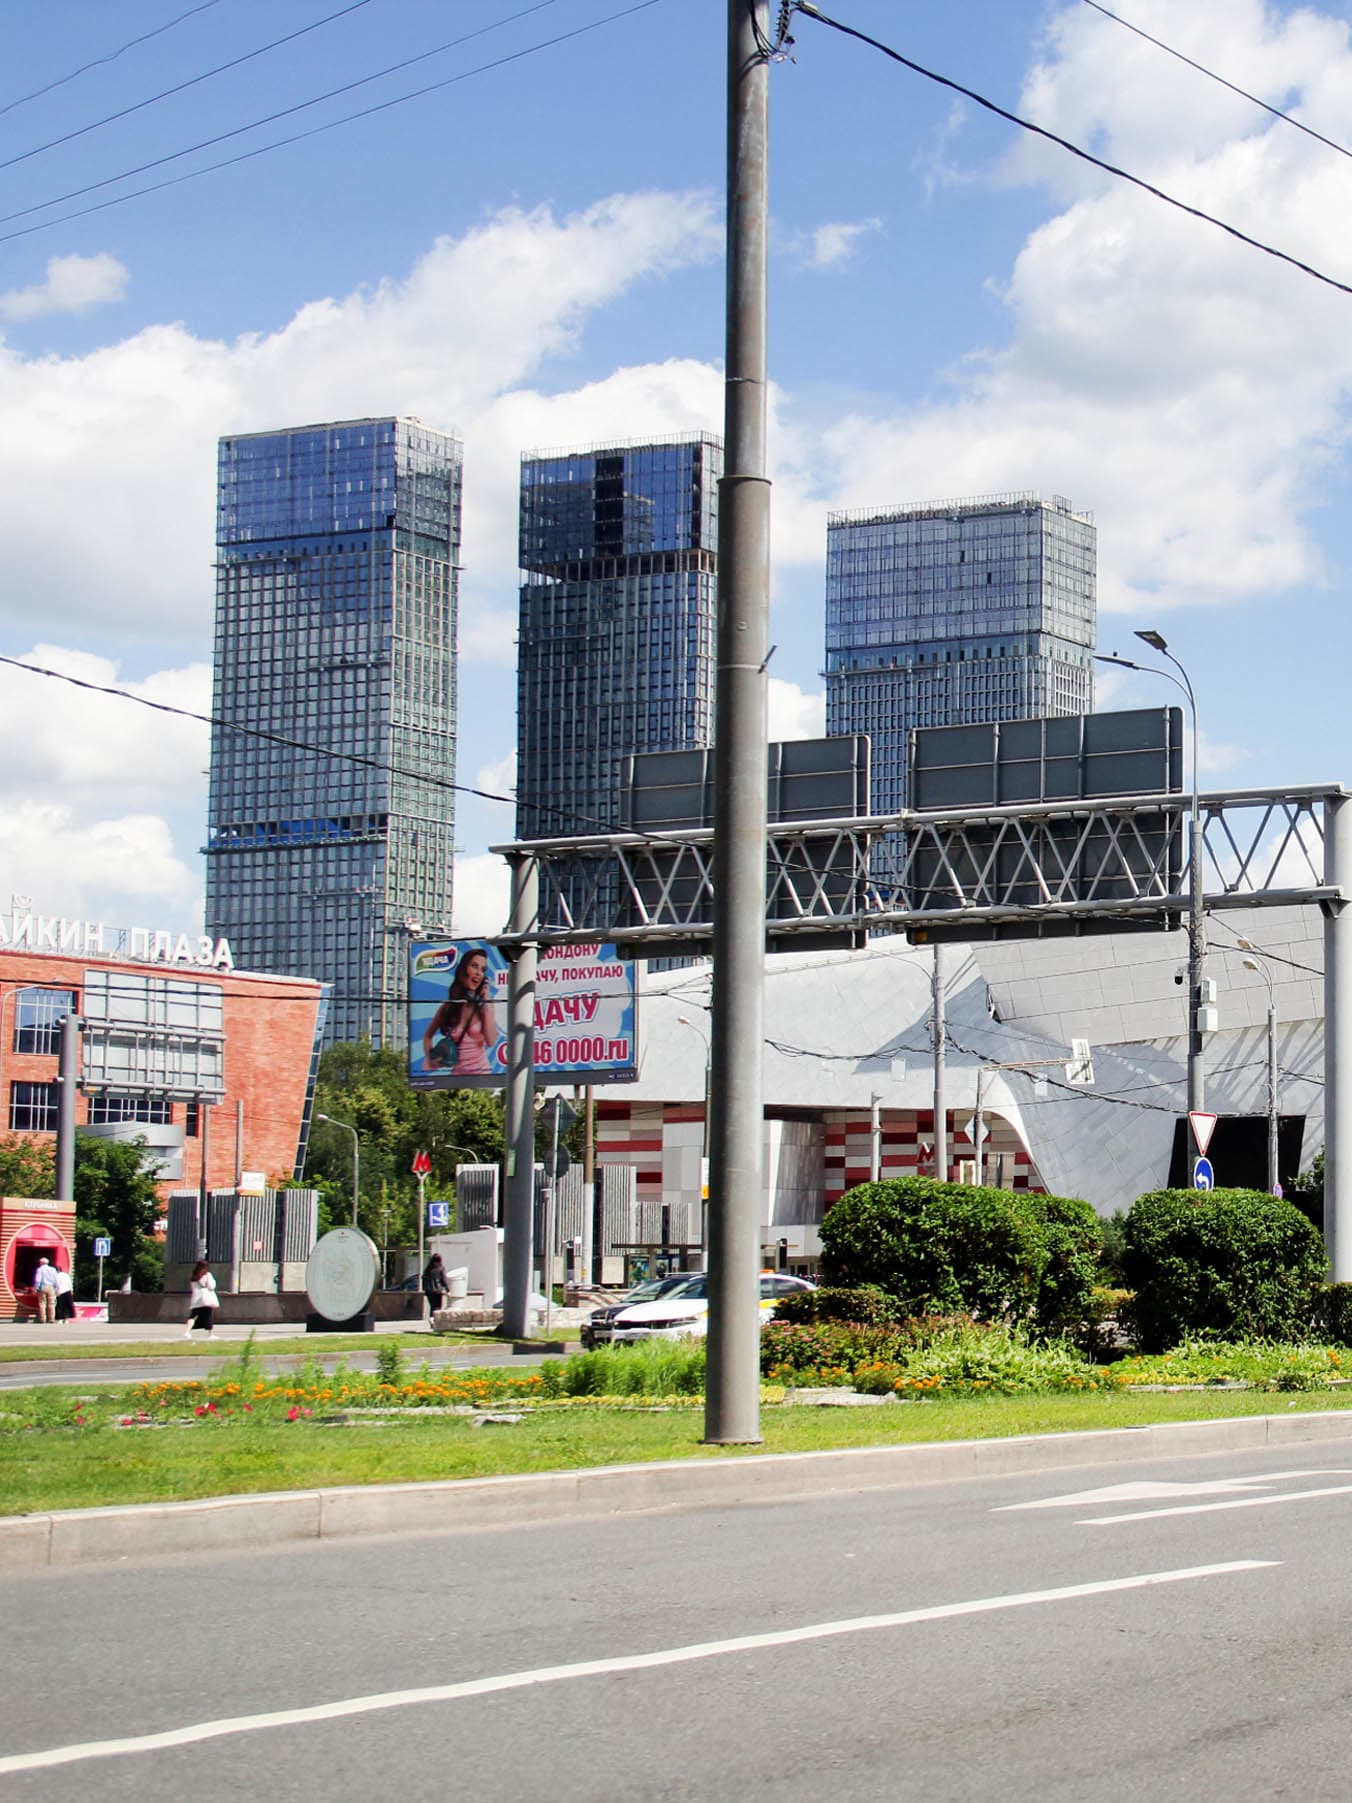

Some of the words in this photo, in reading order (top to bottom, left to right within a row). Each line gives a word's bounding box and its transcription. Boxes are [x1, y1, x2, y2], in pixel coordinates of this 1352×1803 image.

[129, 927, 235, 969] ПЛАЗА
[543, 944, 599, 960] ОНДОНУ
[561, 965, 623, 981] ПОКУПАЮ
[556, 1036, 628, 1063] 0000.ru
